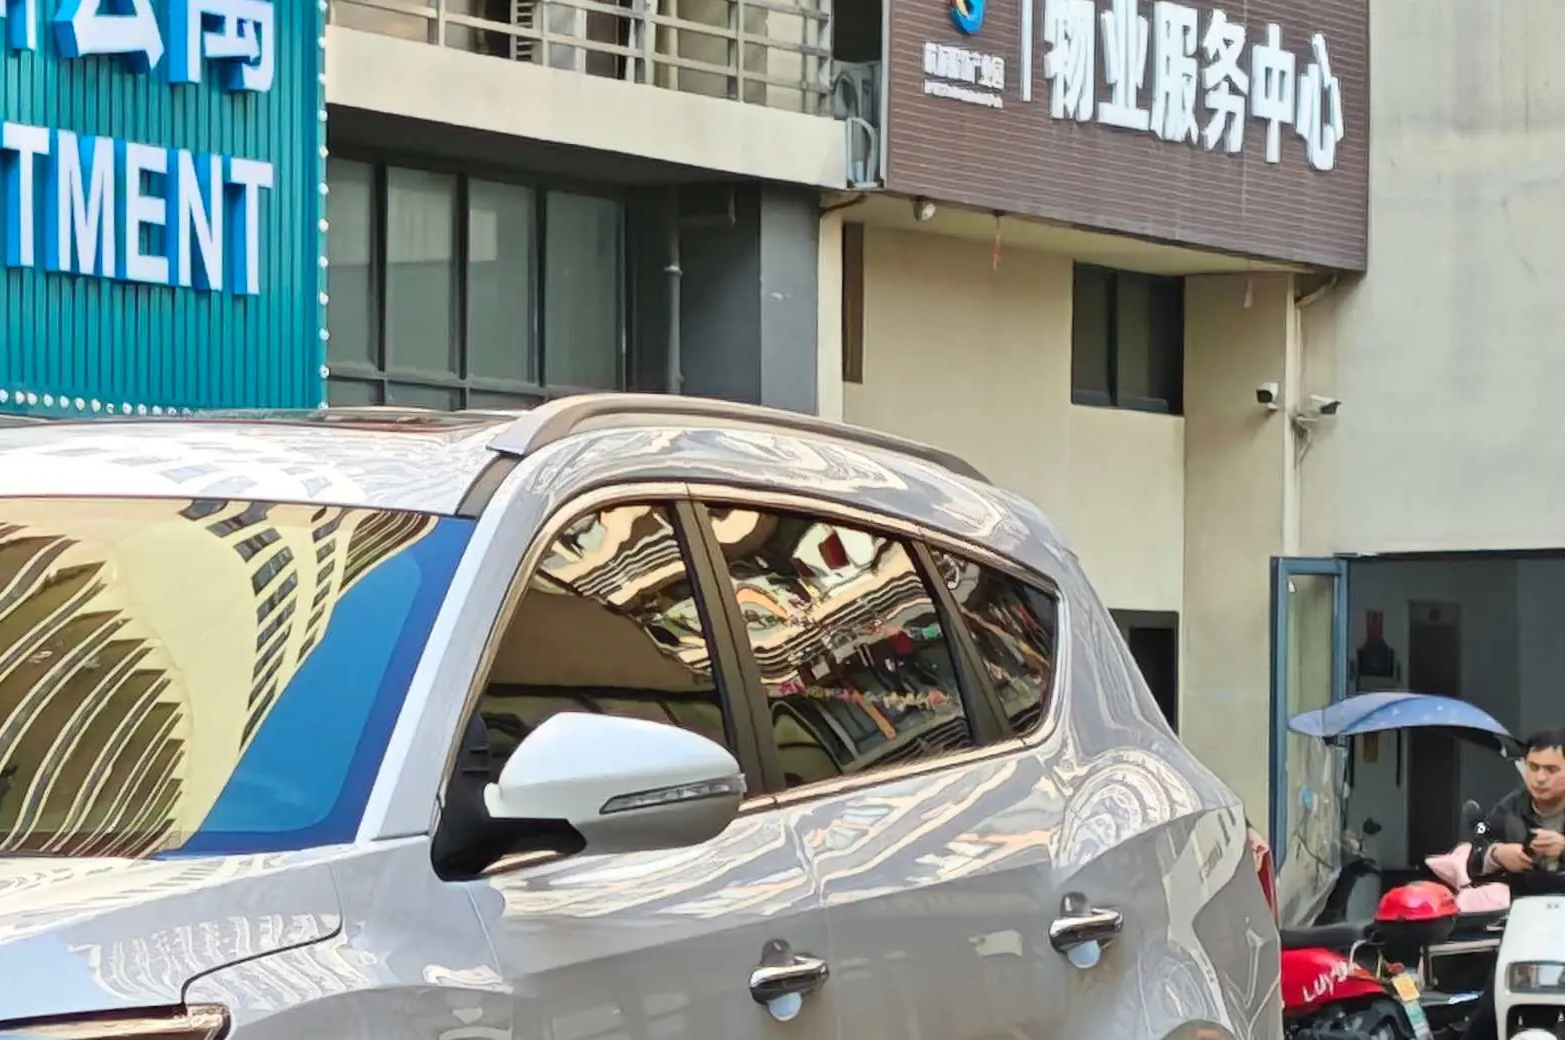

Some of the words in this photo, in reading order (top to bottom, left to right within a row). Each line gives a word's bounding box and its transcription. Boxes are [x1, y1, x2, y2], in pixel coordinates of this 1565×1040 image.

[1043, 0, 1345, 171] 物业服务中心
